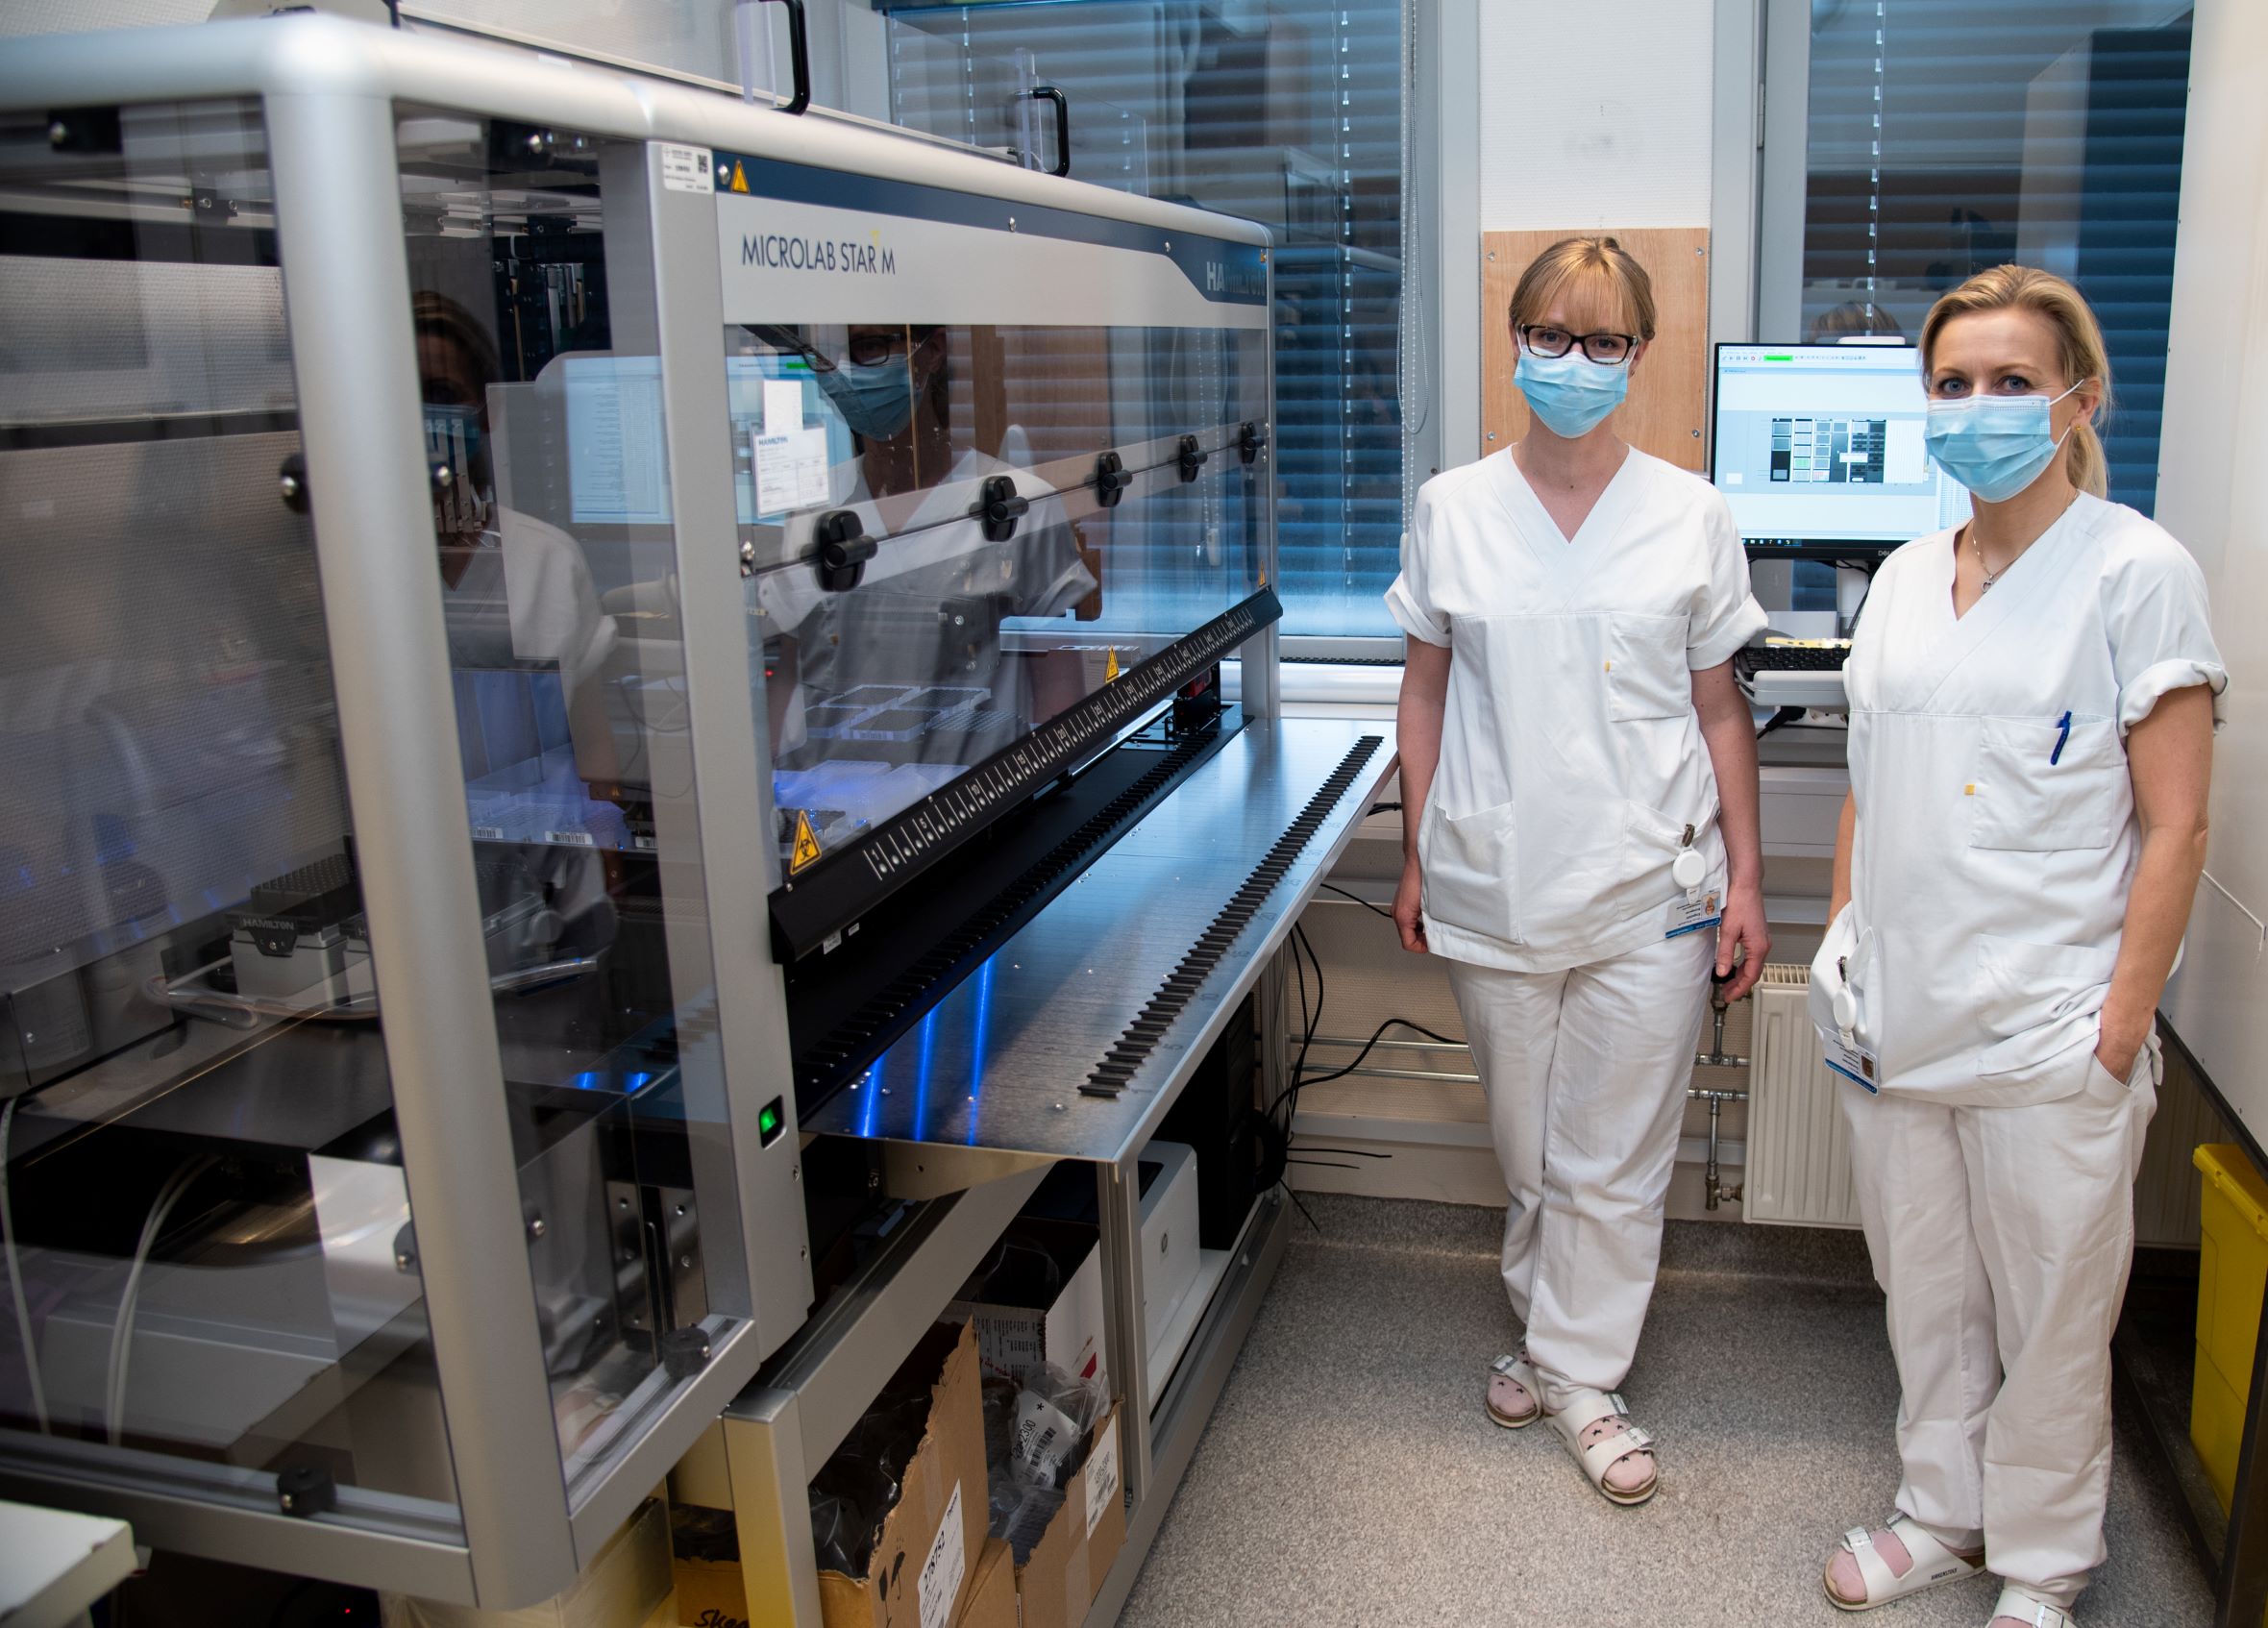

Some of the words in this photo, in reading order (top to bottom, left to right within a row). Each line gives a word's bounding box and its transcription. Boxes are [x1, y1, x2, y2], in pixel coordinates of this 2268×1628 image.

[742, 234, 836, 271] MICROLAB
[841, 242, 876, 274] STAR
[882, 248, 896, 275] M
[919, 818, 927, 829] 5
[971, 783, 981, 796] 10
[1017, 753, 1026, 765] 15
[1057, 728, 1067, 740] 20
[242, 918, 295, 931] HAMILTON
